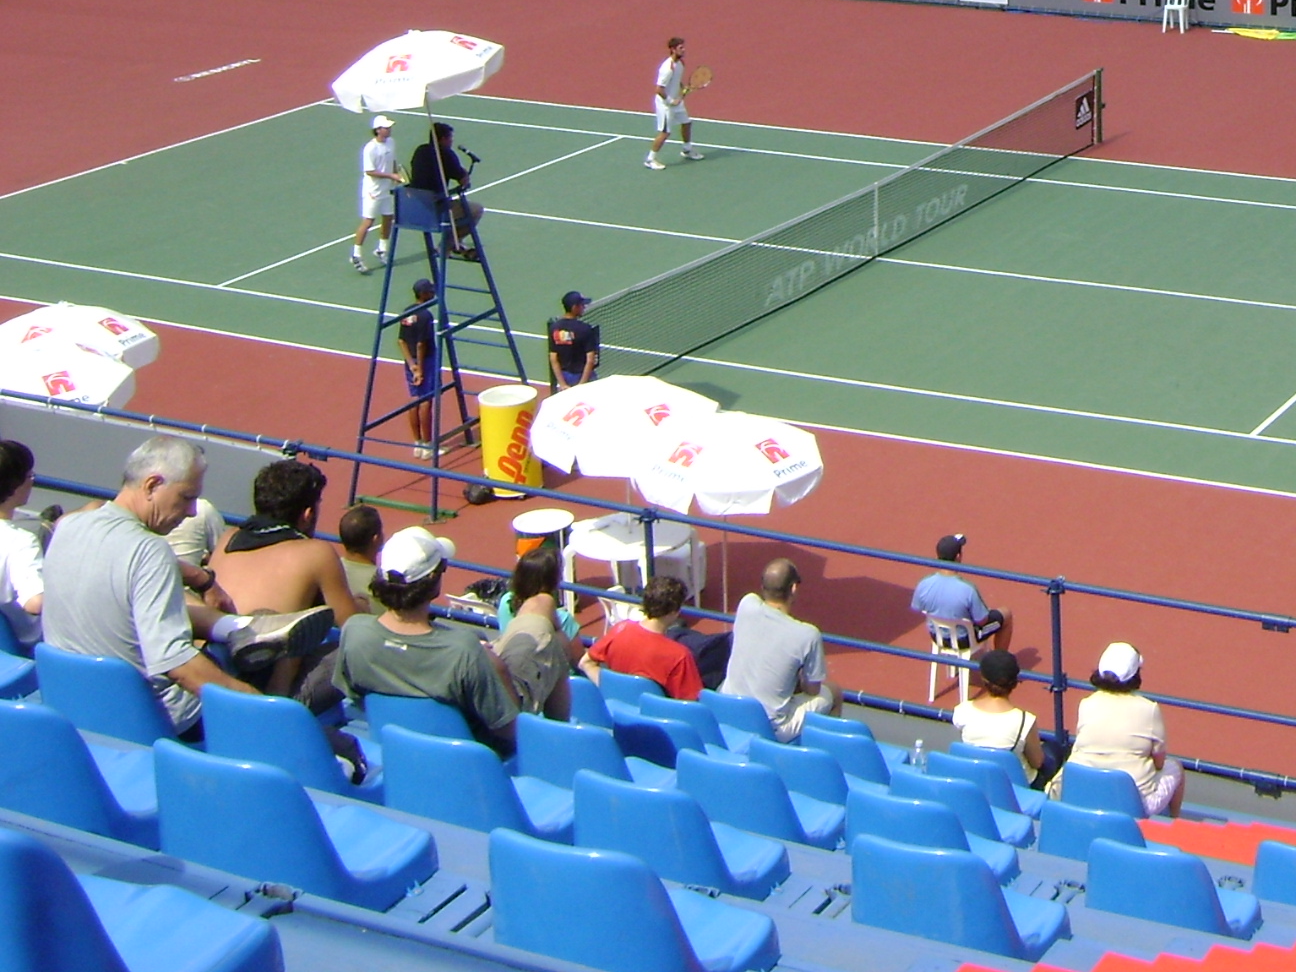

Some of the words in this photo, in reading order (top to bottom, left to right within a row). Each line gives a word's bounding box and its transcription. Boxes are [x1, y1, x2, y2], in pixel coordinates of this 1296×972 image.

[764, 260, 815, 307] ATP
[822, 215, 906, 276] WORLD
[914, 184, 969, 230] TOUR
[118, 332, 146, 346] Prime
[774, 459, 807, 478] Prime
